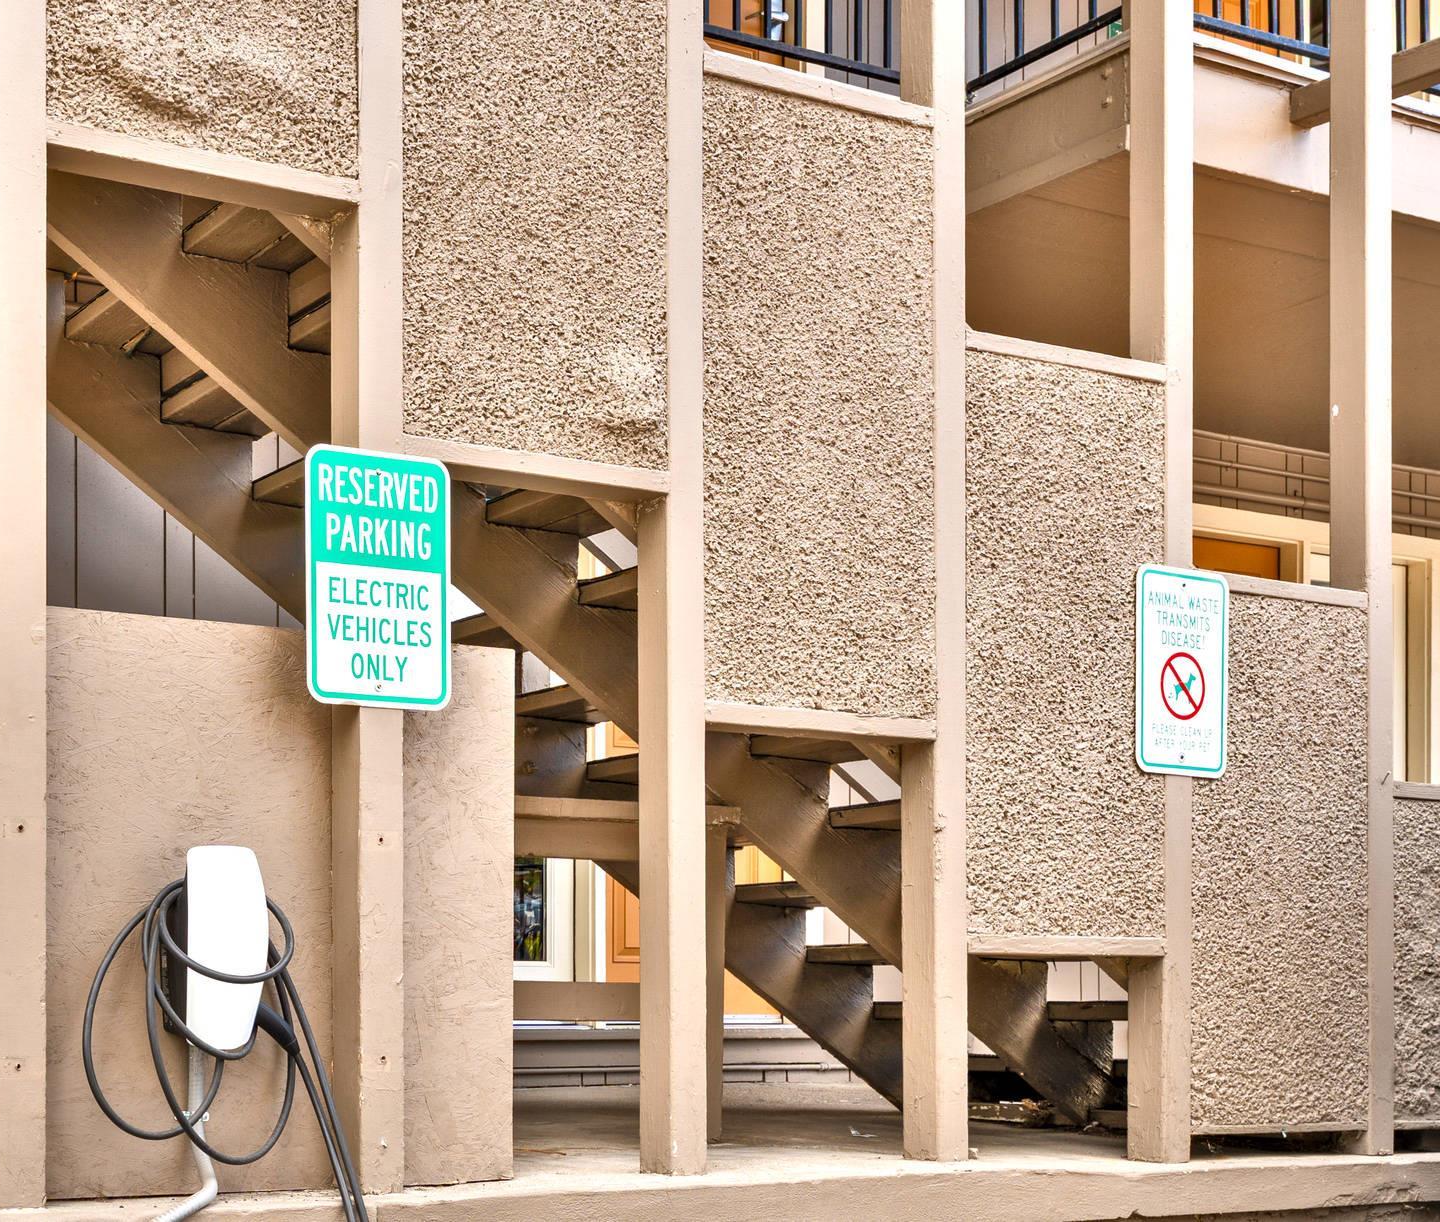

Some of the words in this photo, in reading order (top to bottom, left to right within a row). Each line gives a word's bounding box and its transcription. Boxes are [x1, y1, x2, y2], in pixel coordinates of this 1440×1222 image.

[318, 463, 438, 513] RESERVED
[326, 512, 432, 561] PARKING
[328, 576, 429, 611] ELECTRIC
[1148, 590, 1184, 609] ANIMAL
[1188, 595, 1219, 615] WASTE
[327, 613, 432, 648] VEHICLES
[1156, 609, 1210, 632] TRANSMITS
[1161, 630, 1206, 650] DISEASE!
[351, 652, 408, 682] ONLY
[1152, 722, 1177, 736] PLEASE
[1180, 726, 1201, 738] CLEAN
[1155, 738, 1174, 749] AFTER
[1177, 740, 1195, 751] YOUR
